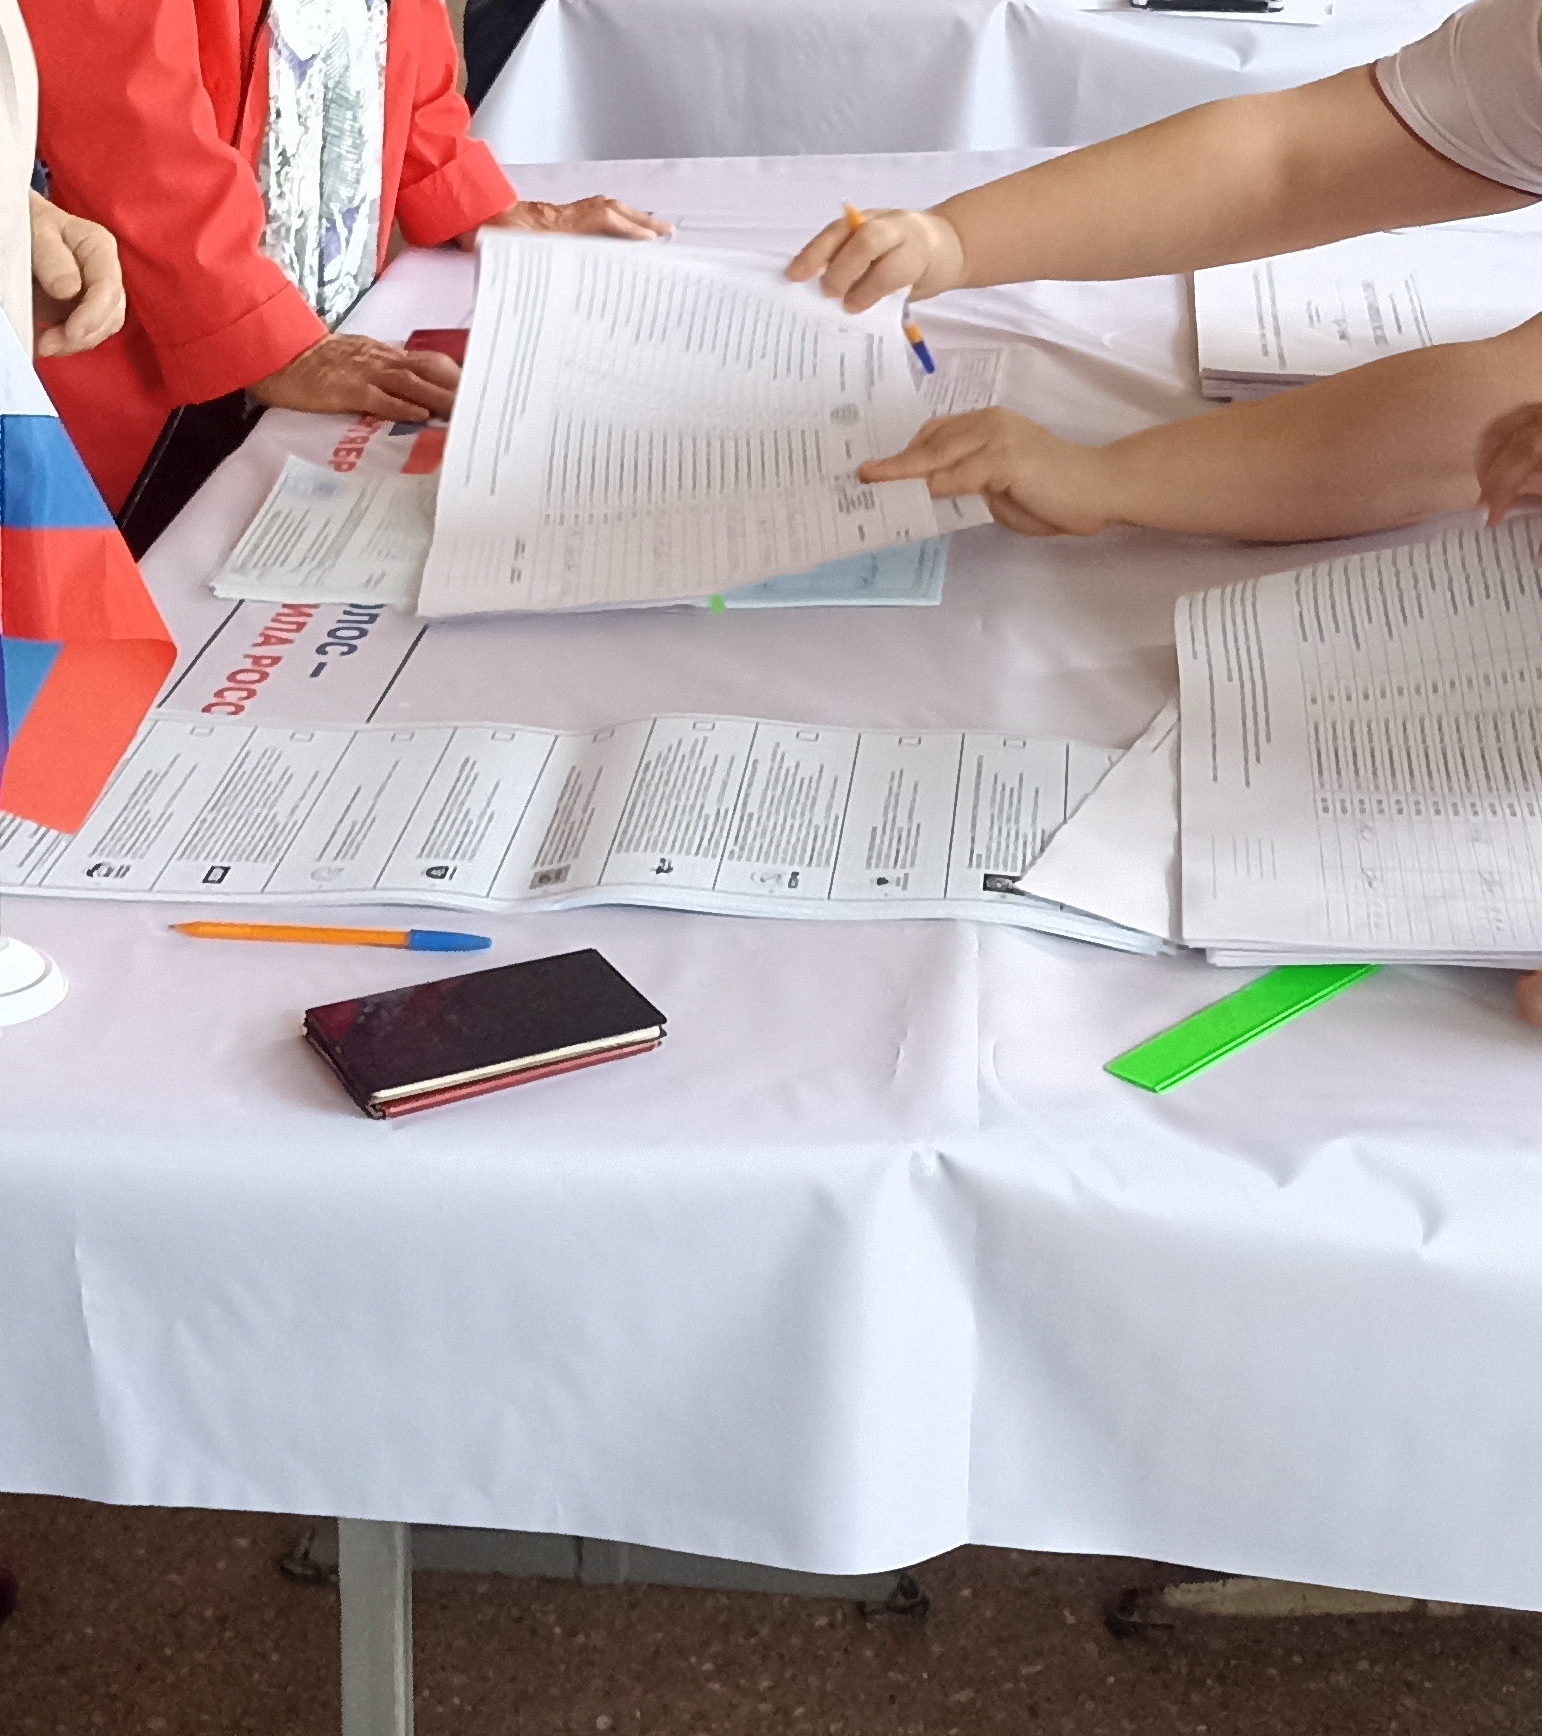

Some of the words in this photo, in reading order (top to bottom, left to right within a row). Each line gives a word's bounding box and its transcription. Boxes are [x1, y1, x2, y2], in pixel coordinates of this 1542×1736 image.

[326, 416, 382, 474] ТЯБР
[252, 602, 322, 649] ИЛА
[200, 653, 284, 716] РОСС
